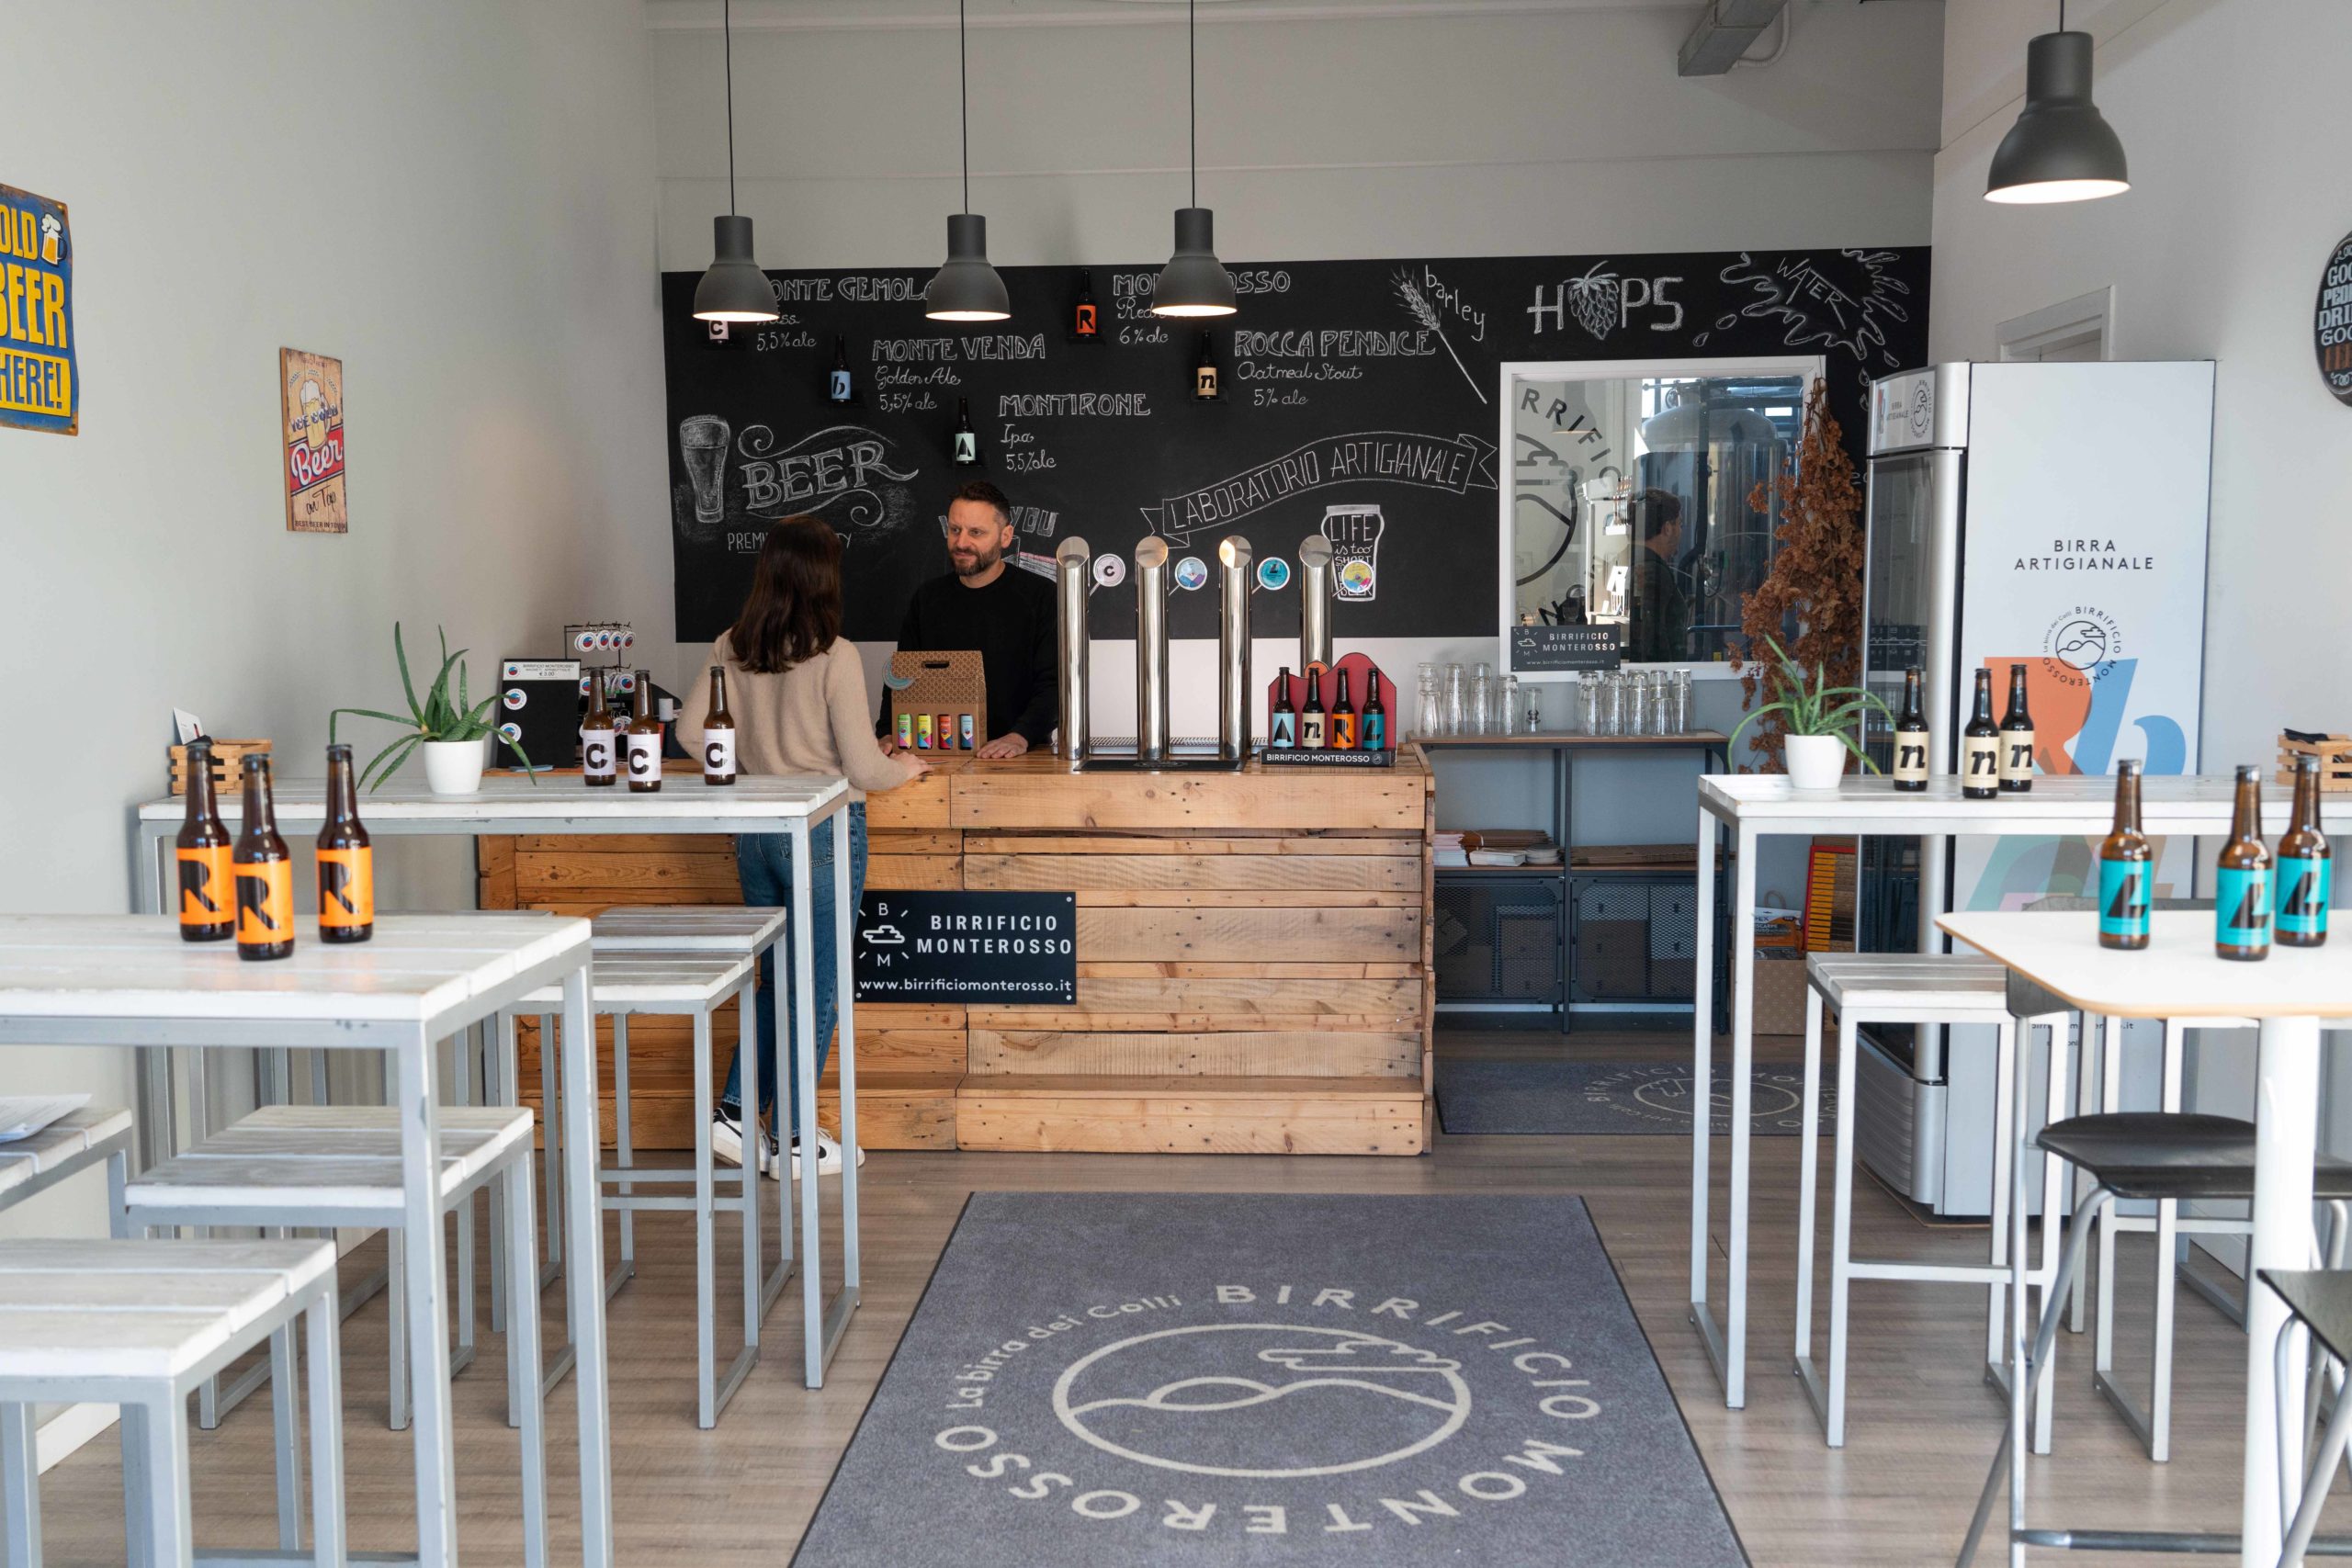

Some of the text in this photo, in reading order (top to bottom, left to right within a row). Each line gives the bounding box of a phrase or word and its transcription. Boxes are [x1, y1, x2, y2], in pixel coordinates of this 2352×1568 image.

[0, 204, 39, 261] OLD
[2327, 262, 2352, 287] GO
[770, 278, 833, 301] ONTE
[1776, 257, 1859, 331] WATER
[1425, 265, 1486, 341] barley
[1079, 310, 1094, 329] R
[2318, 304, 2352, 331] DRI
[872, 333, 1046, 362] MONTE VENDA
[1234, 330, 1436, 356] ROCCA PENDICE
[2321, 325, 2352, 346] GO
[875, 366, 961, 389] Golden Ale
[1237, 361, 1363, 380] Oatmeal Stout
[998, 393, 1150, 417] MONTIRONE
[957, 437, 972, 457] A
[1001, 423, 1034, 448] Ipa
[291, 440, 343, 486] Beer
[740, 440, 919, 510] BEER
[1170, 441, 1465, 529] LABORATORIO ARTIGIANALE
[1330, 514, 1374, 541] LIFE
[1335, 544, 1373, 555] is too
[2054, 539, 2116, 552] BIRRA
[2014, 557, 2154, 570] ARTIGIANALE
[1549, 632, 1609, 640] BIRRIFICIO
[2075, 606, 2121, 653] BIRRIFICIO
[1543, 643, 1615, 651] MONTEROSSO
[2042, 658, 2117, 686] MONTEROSSO
[1273, 717, 1292, 742] A
[1304, 722, 1320, 739] n
[1334, 718, 1351, 743] R
[585, 743, 607, 769] C
[629, 749, 650, 774] C
[706, 743, 728, 768] C
[1266, 753, 1370, 762] BIRRIFICIO MONTEROSSO
[1900, 745, 1925, 768] n
[1972, 750, 1996, 774] n
[178, 859, 220, 913] R
[318, 861, 359, 915] R
[235, 875, 280, 931] R
[878, 902, 888, 916] B
[931, 915, 1057, 931] BIRRIFICIO
[917, 938, 1071, 953] MONTEROSSO
[877, 953, 890, 966] M
[860, 978, 1071, 991] www.birrificiomonterosso.it
[1583, 1066, 1689, 1101] BIRRIFICI
[934, 1284, 1601, 1533] La birra dei Colli BIRRIFICIO MONTEROSSO
